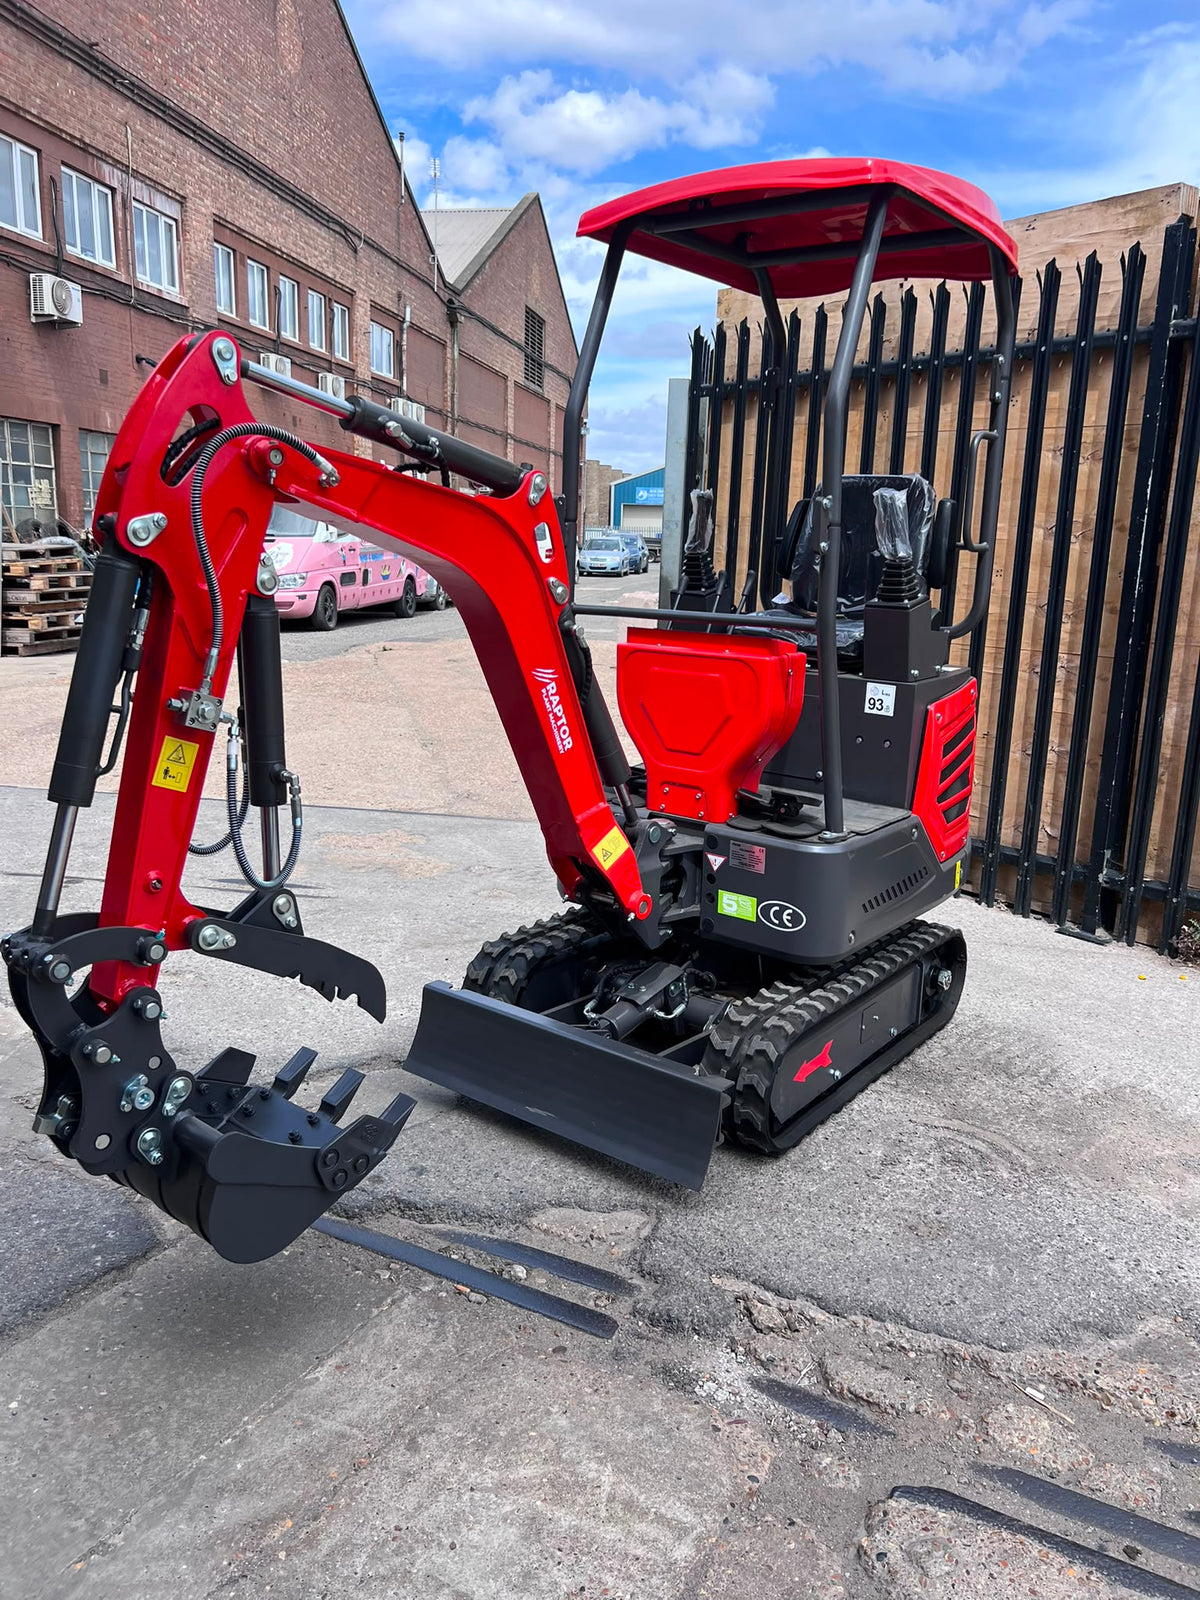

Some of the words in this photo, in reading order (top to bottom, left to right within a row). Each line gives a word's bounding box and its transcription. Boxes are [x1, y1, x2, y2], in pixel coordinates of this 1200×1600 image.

[541, 688, 552, 712] PLANT
[549, 712, 565, 754] MACHINERY
[546, 681, 573, 751] RAPTOR
[868, 697, 883, 711] 93
[770, 906, 793, 927] CE
